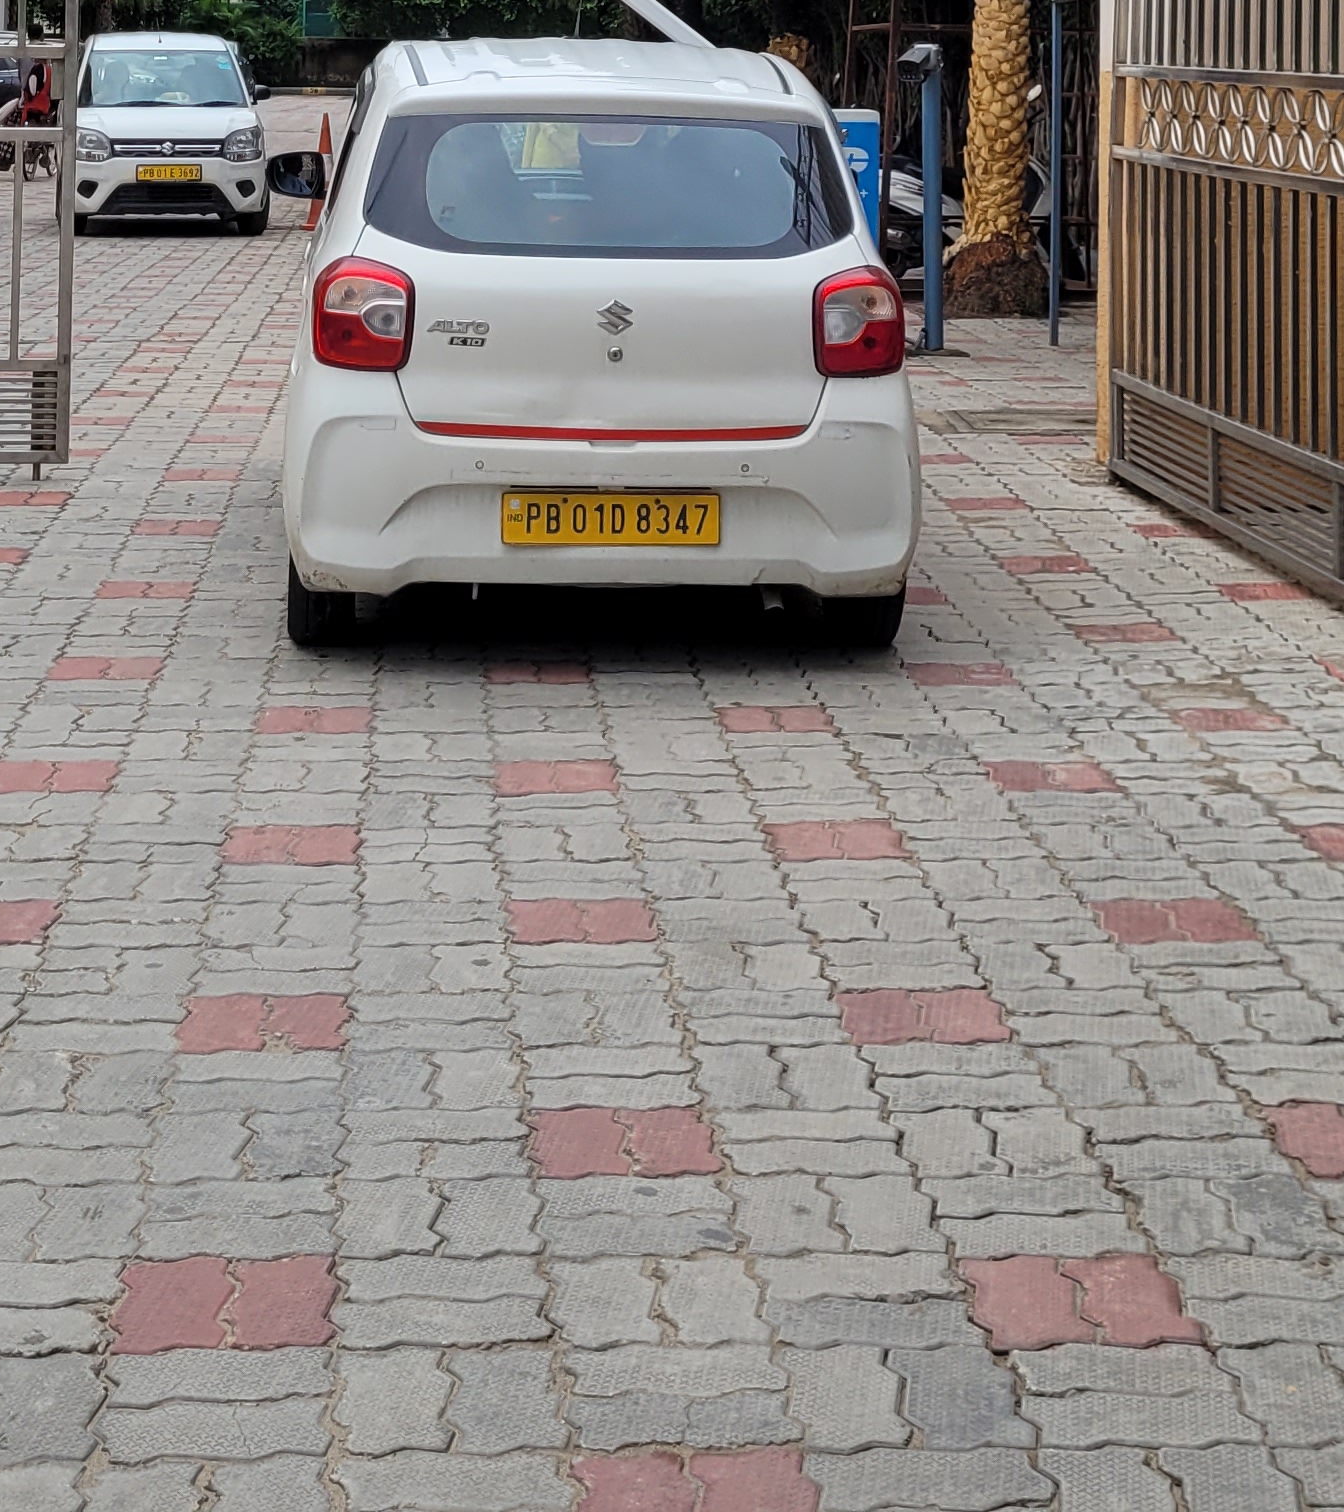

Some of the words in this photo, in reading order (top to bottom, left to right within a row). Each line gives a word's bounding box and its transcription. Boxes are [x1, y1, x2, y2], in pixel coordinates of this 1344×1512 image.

[426, 319, 490, 335] ALTO
[452, 337, 483, 346] K10
[507, 513, 523, 522] IND
[635, 503, 709, 535] 8347
